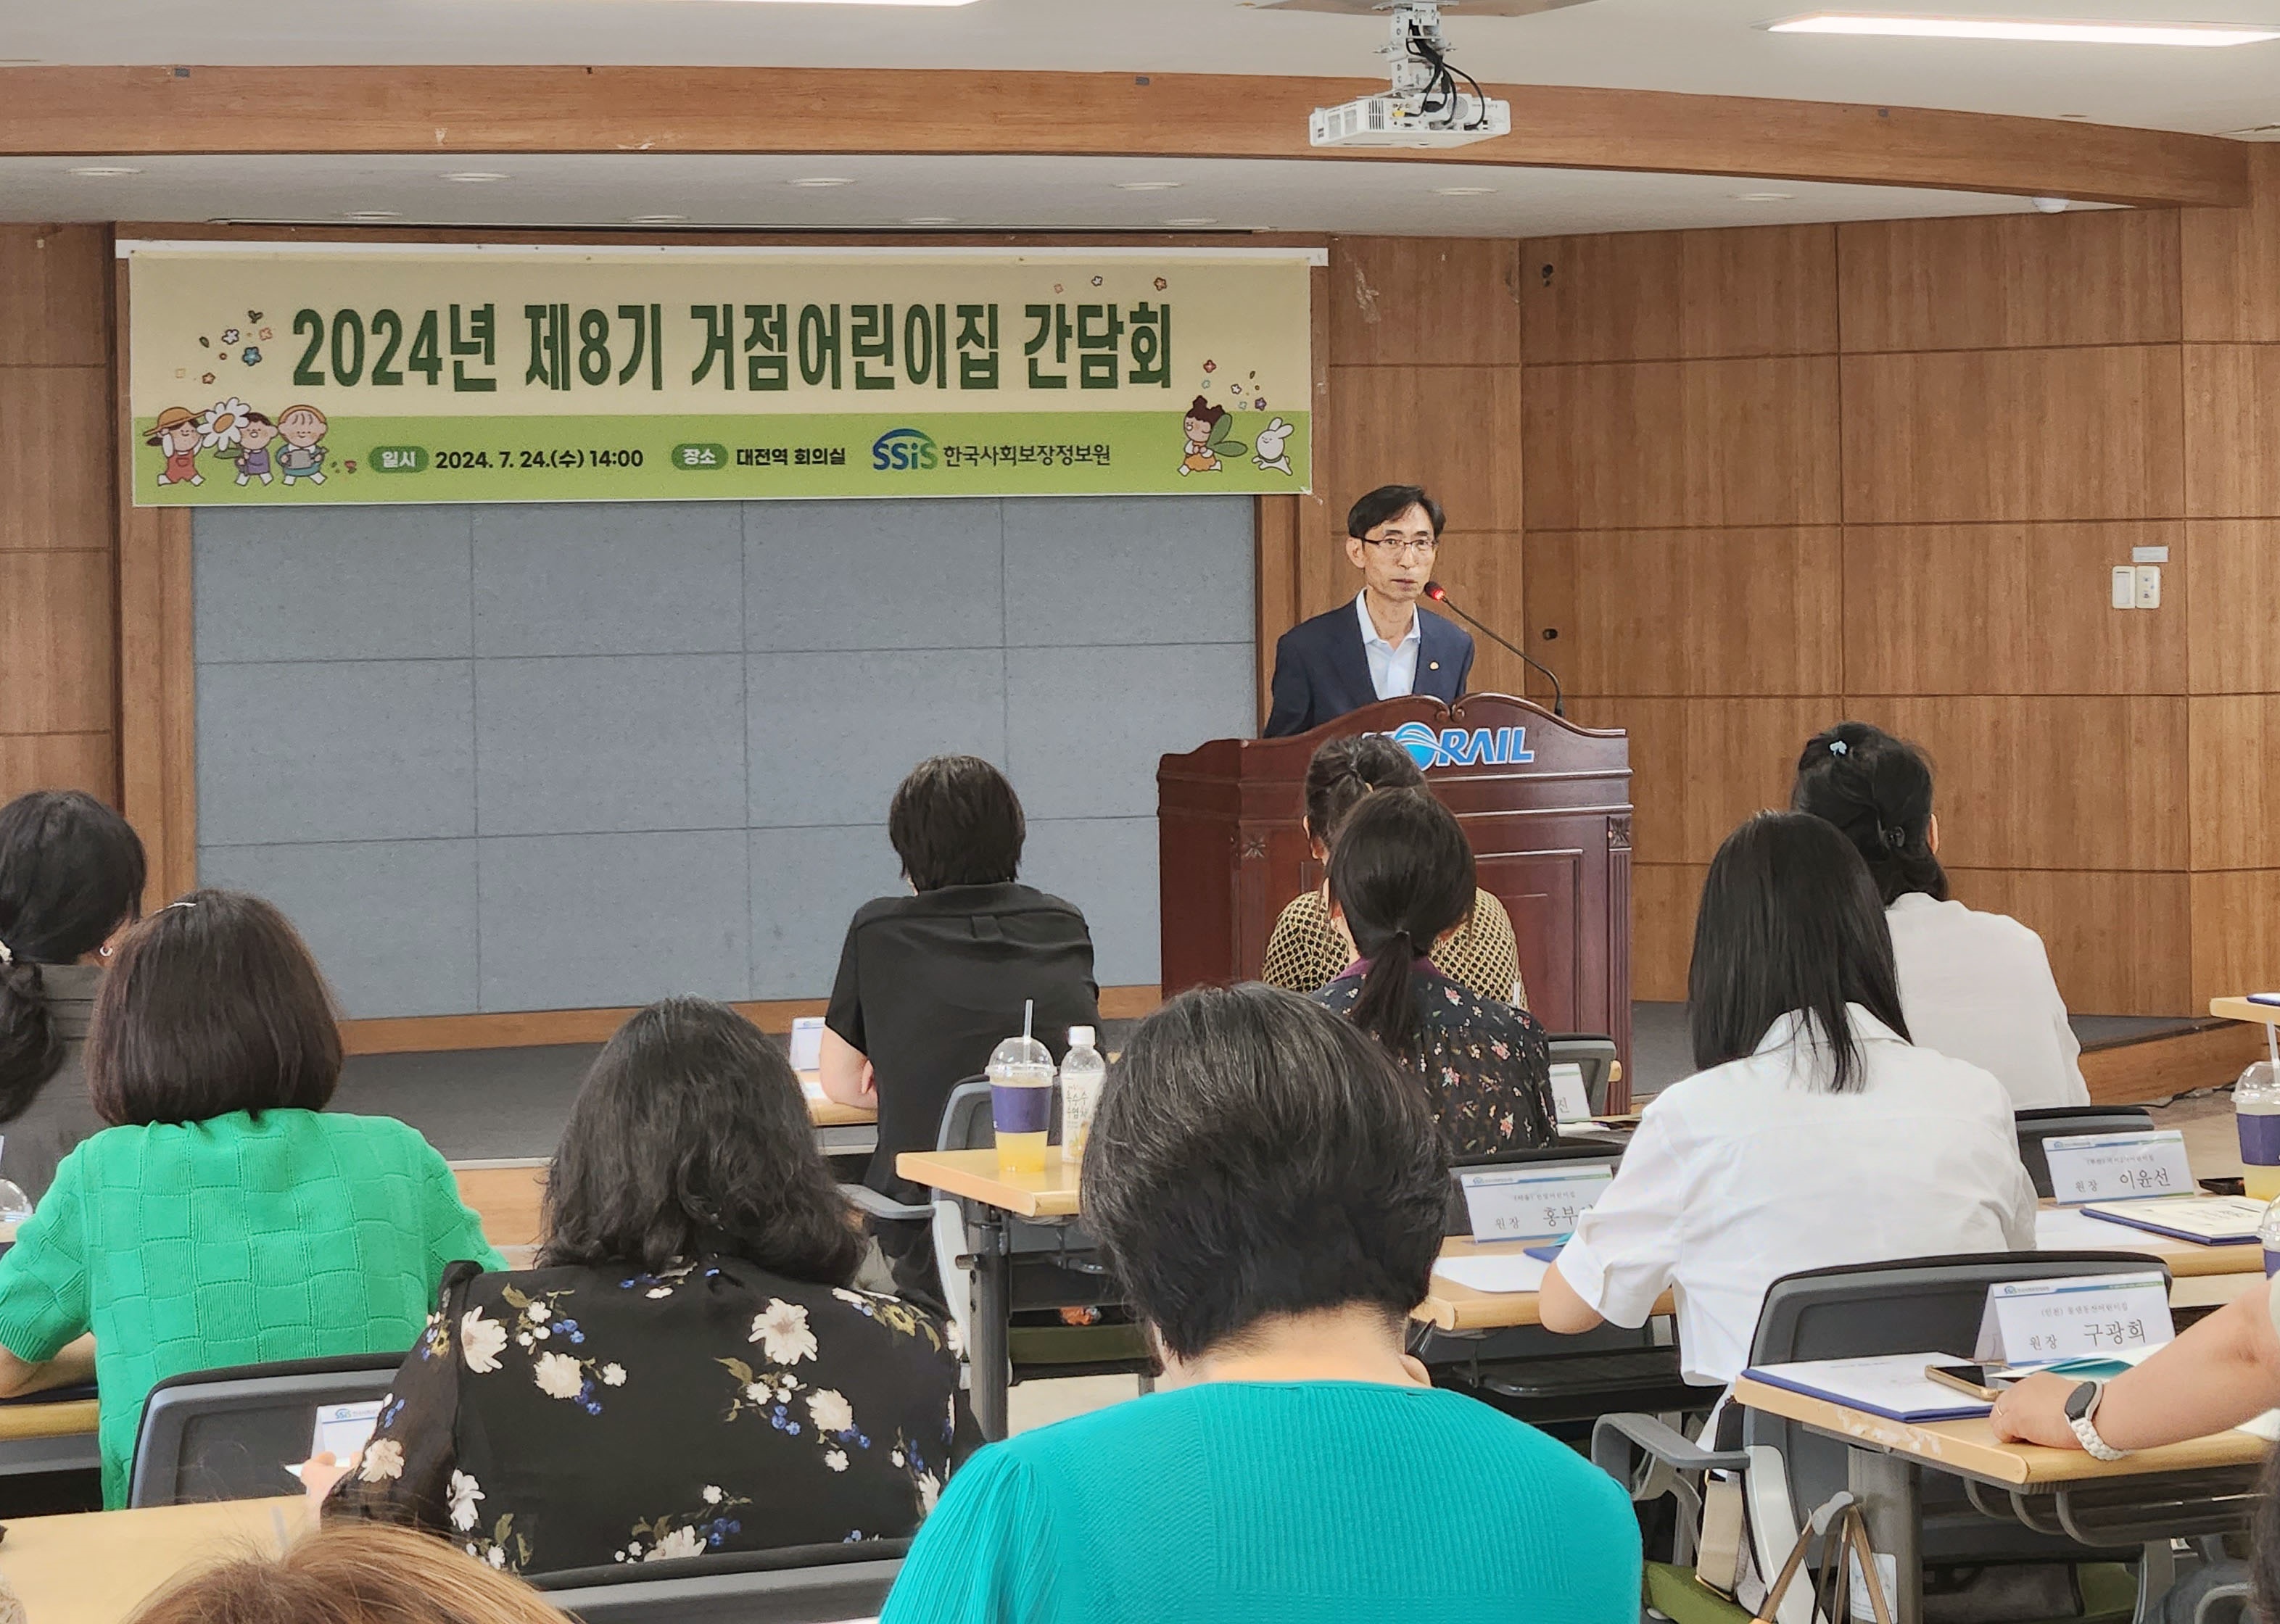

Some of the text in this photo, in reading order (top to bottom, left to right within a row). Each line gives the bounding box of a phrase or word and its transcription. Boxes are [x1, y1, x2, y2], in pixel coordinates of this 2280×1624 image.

[293, 302, 1171, 392] 2024년 제8기 거점어린이집 간담회
[381, 450, 643, 469] 일시 2024. 7. 24.(수) 14:00
[682, 447, 846, 466] 장소 대전역 회의실
[943, 444, 1111, 467] 한국사회보장정보원
[1362, 722, 1535, 771] ORAIL
[2075, 1180, 2098, 1193] 원장
[2119, 1167, 2170, 1190] 이윤선
[1495, 1217, 1520, 1231] 원장
[1542, 1204, 1594, 1227] 홍부
[2030, 1334, 2058, 1351] 원장
[2083, 1319, 2147, 1346] 구광희
